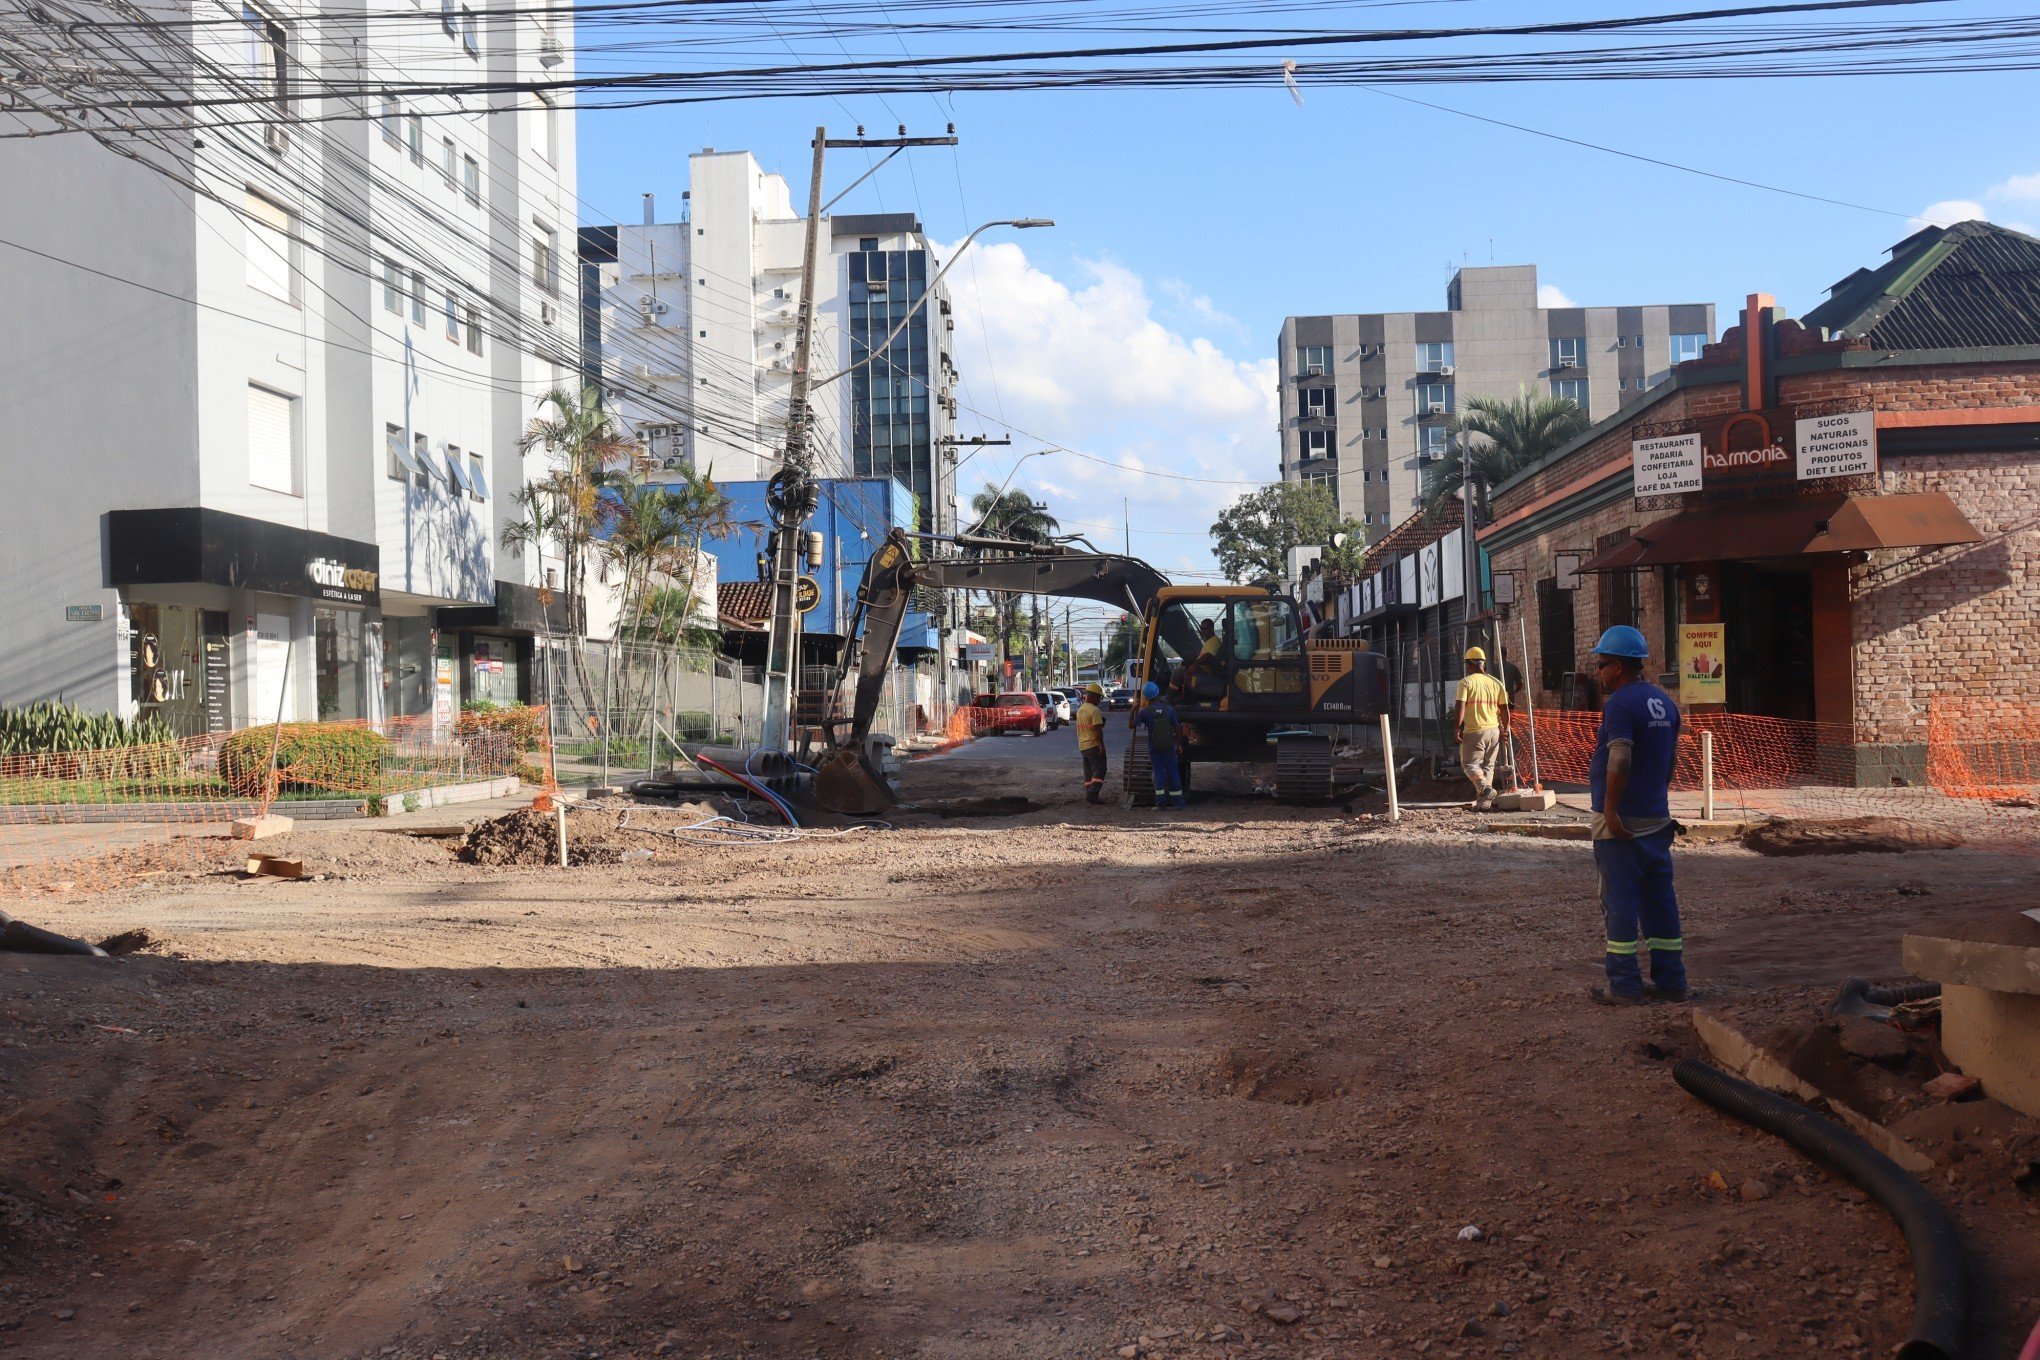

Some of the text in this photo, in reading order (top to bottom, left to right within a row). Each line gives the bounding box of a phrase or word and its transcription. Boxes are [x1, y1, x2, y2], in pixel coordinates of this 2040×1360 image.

[1817, 417, 1849, 428] SUCOS
[1810, 428, 1858, 441] NATURAIS
[1640, 438, 1695, 451] RESTAURANTE
[1801, 439, 1868, 454] E FUNCIONAIS
[1650, 450, 1683, 461] PADARIA
[1703, 444, 1788, 468] harmonia
[1811, 451, 1862, 464] PRODUTOS
[1641, 459, 1694, 472] CONFEITARIA
[1806, 462, 1868, 476] DIET E LIGHT
[1657, 471, 1678, 480] LOJA
[1660, 481, 1671, 490] DA
[1673, 479, 1701, 489] TARDE
[348, 593, 363, 602] LASER
[1686, 631, 1719, 639] COMPRE
[1693, 640, 1712, 648] AQUI
[1283, 673, 1330, 681] VOVO
